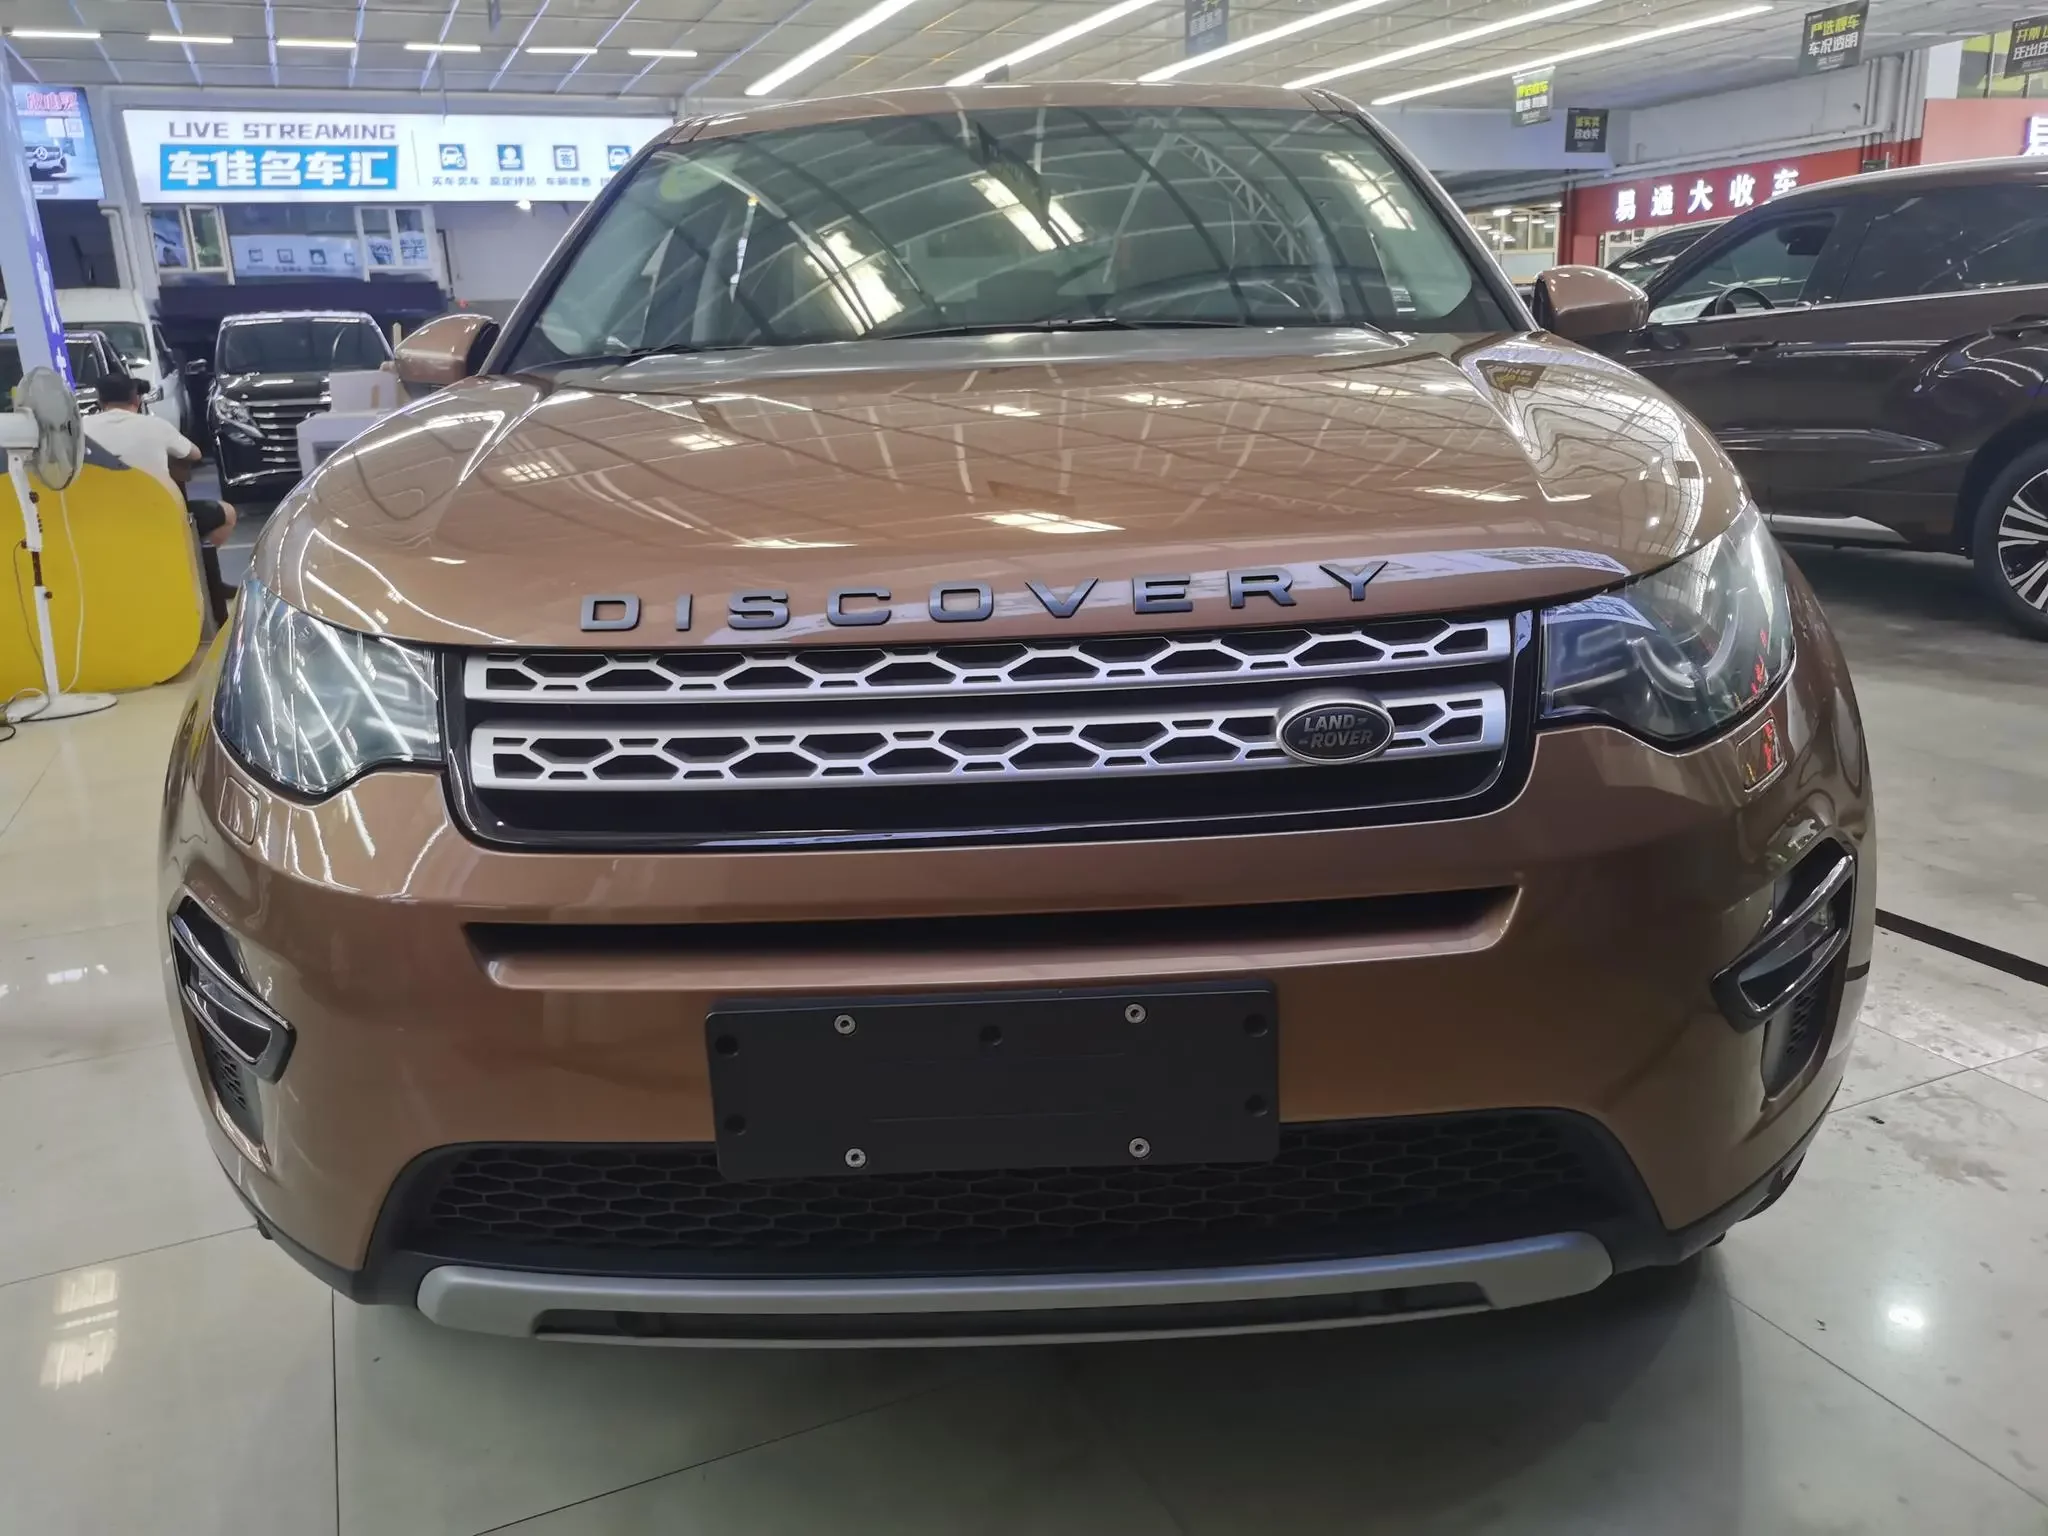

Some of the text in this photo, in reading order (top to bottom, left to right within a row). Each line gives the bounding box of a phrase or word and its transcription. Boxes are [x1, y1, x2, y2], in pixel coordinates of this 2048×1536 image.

[1807, 31, 1859, 57] 车况透明
[168, 121, 397, 141] LIVE STREAMING
[167, 149, 390, 187] 车佳名车汇
[1615, 168, 1799, 222] 易通大收车
[579, 560, 1389, 633] DISCOVERY
[1303, 714, 1355, 733] LAND
[1310, 730, 1374, 749] ROVER
